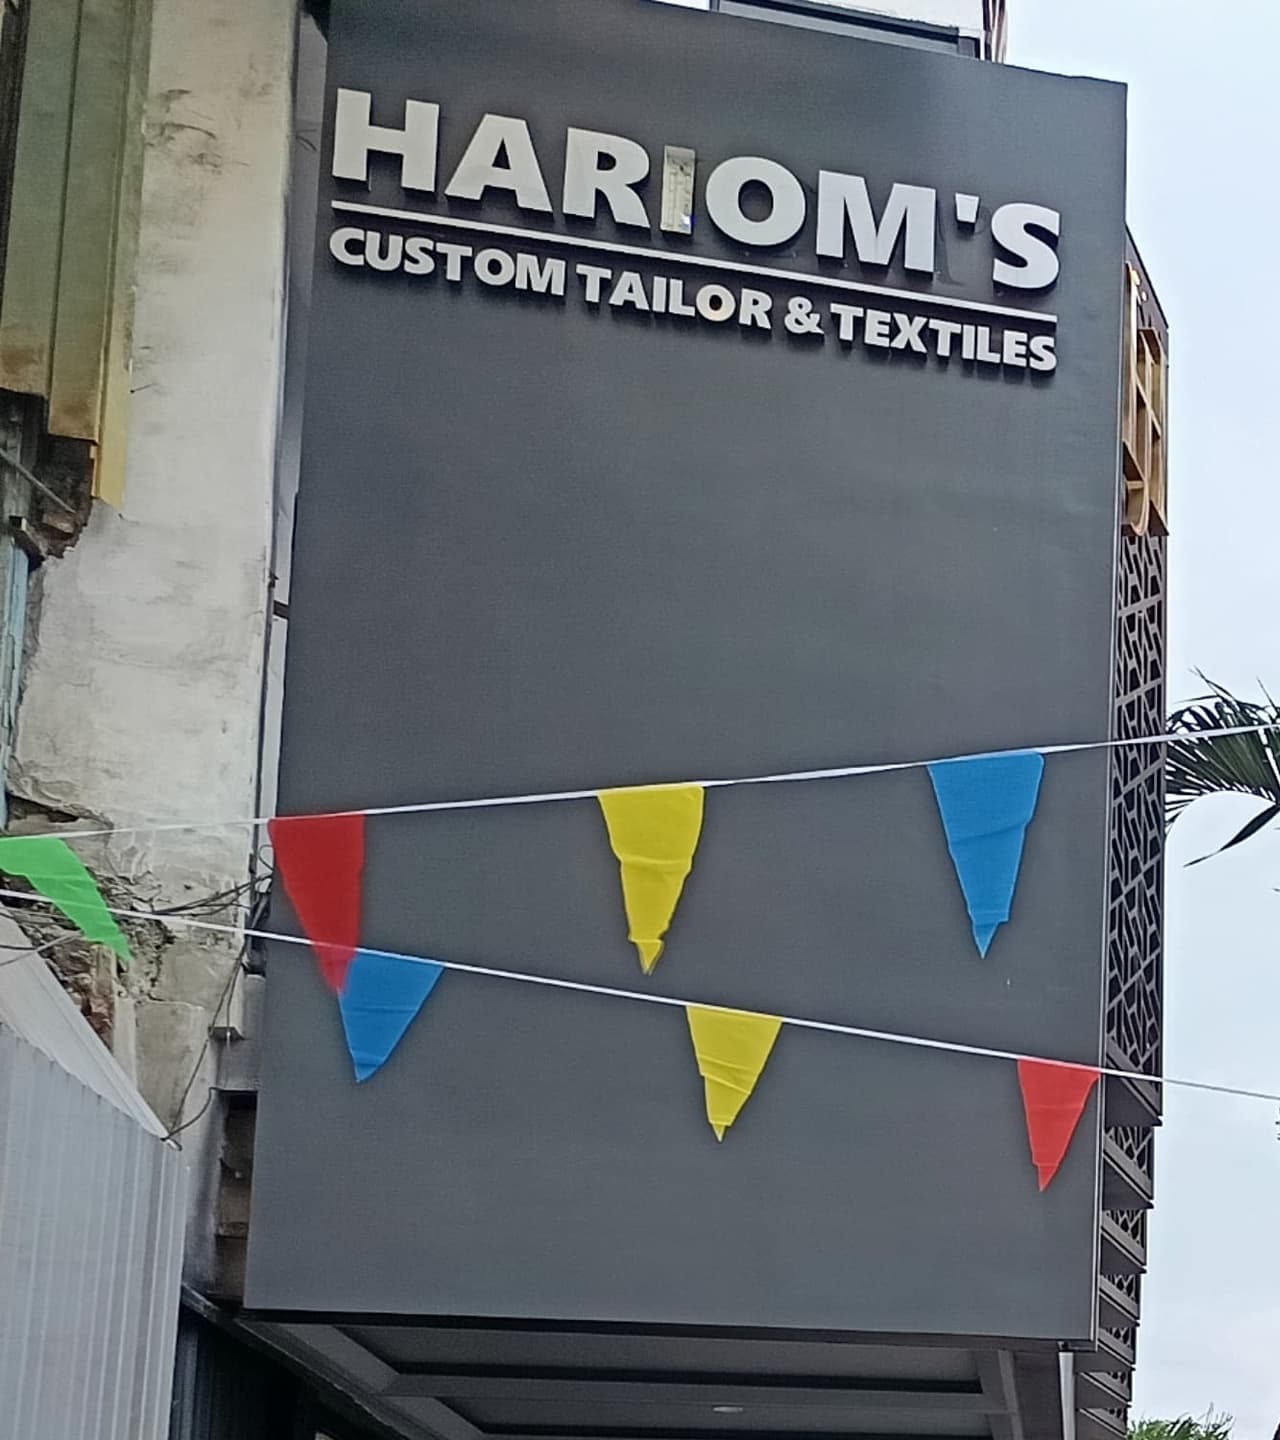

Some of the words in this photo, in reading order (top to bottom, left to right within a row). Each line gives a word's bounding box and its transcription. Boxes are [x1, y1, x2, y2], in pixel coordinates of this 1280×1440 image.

[331, 87, 1061, 290] HARIOM'S
[329, 226, 566, 296] CUSTOM
[576, 263, 772, 330] TAILOR
[784, 295, 825, 336] &
[830, 302, 1058, 373] TEXTILES
